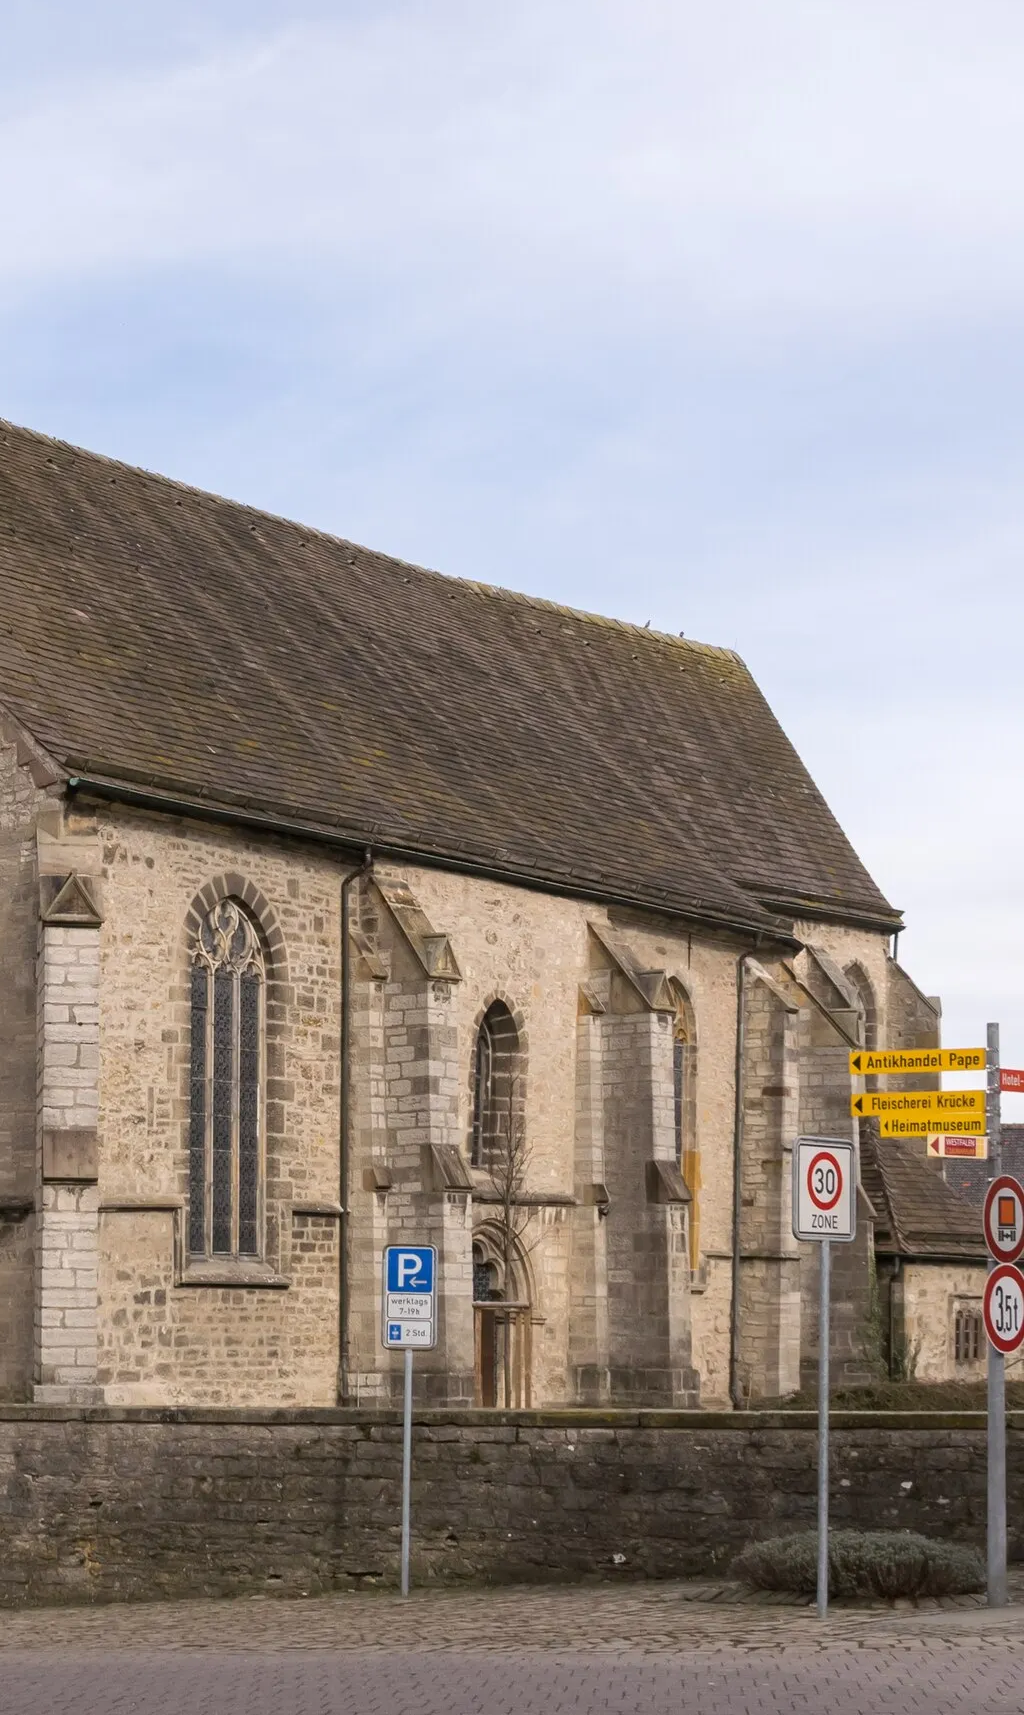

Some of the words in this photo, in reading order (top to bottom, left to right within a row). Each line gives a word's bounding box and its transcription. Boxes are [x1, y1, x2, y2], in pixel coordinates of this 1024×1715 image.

[866, 1053, 942, 1069] Antikhandel
[949, 1052, 980, 1068] Pape
[872, 1098, 931, 1110] Fleischerei
[938, 1095, 975, 1107] Krücke
[892, 1120, 981, 1133] Heimatmuseum
[946, 1138, 975, 1147] WESTFALEN
[815, 1168, 835, 1194] 30
[811, 1214, 838, 1229] ZONE
[398, 1254, 422, 1287] P
[391, 1298, 428, 1306] werktags
